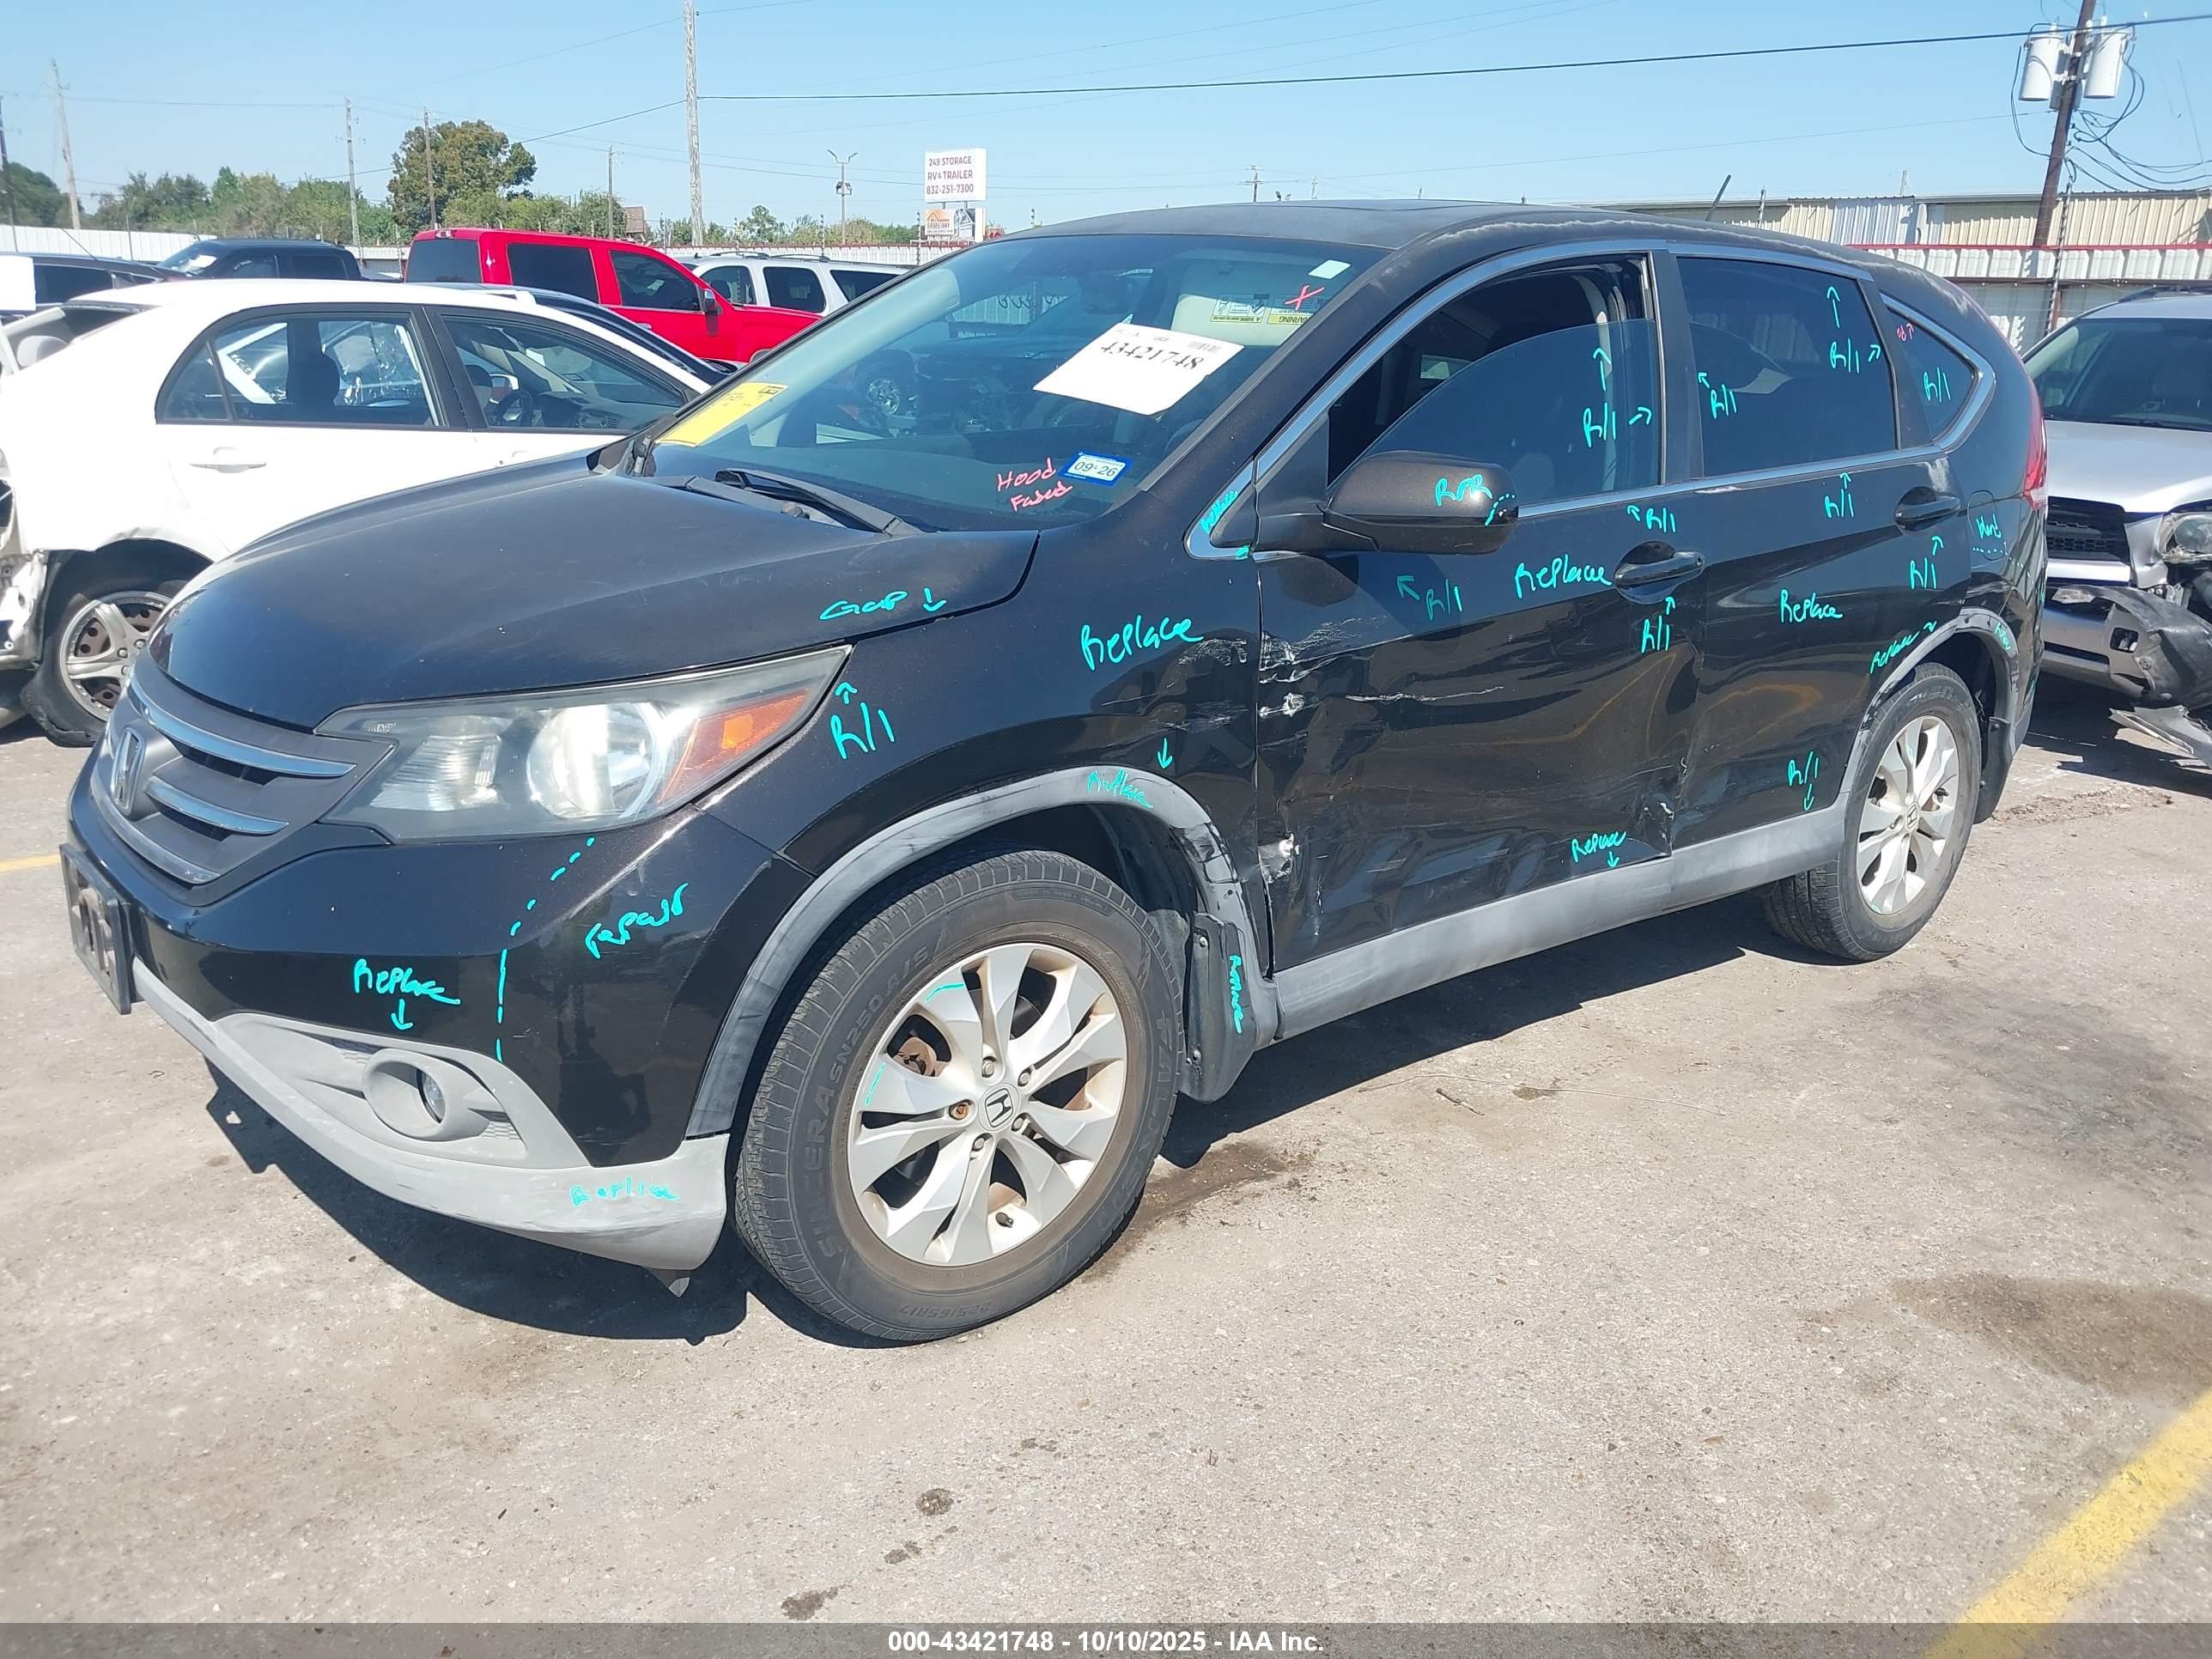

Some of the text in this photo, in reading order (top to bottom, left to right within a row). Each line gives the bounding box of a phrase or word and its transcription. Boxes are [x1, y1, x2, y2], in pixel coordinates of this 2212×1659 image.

[941, 155, 972, 166] STORAGE
[927, 171, 937, 181] RV
[942, 169, 973, 179] TRAILER
[1100, 341, 1205, 370] 43421748
[997, 457, 1057, 491] Hood
